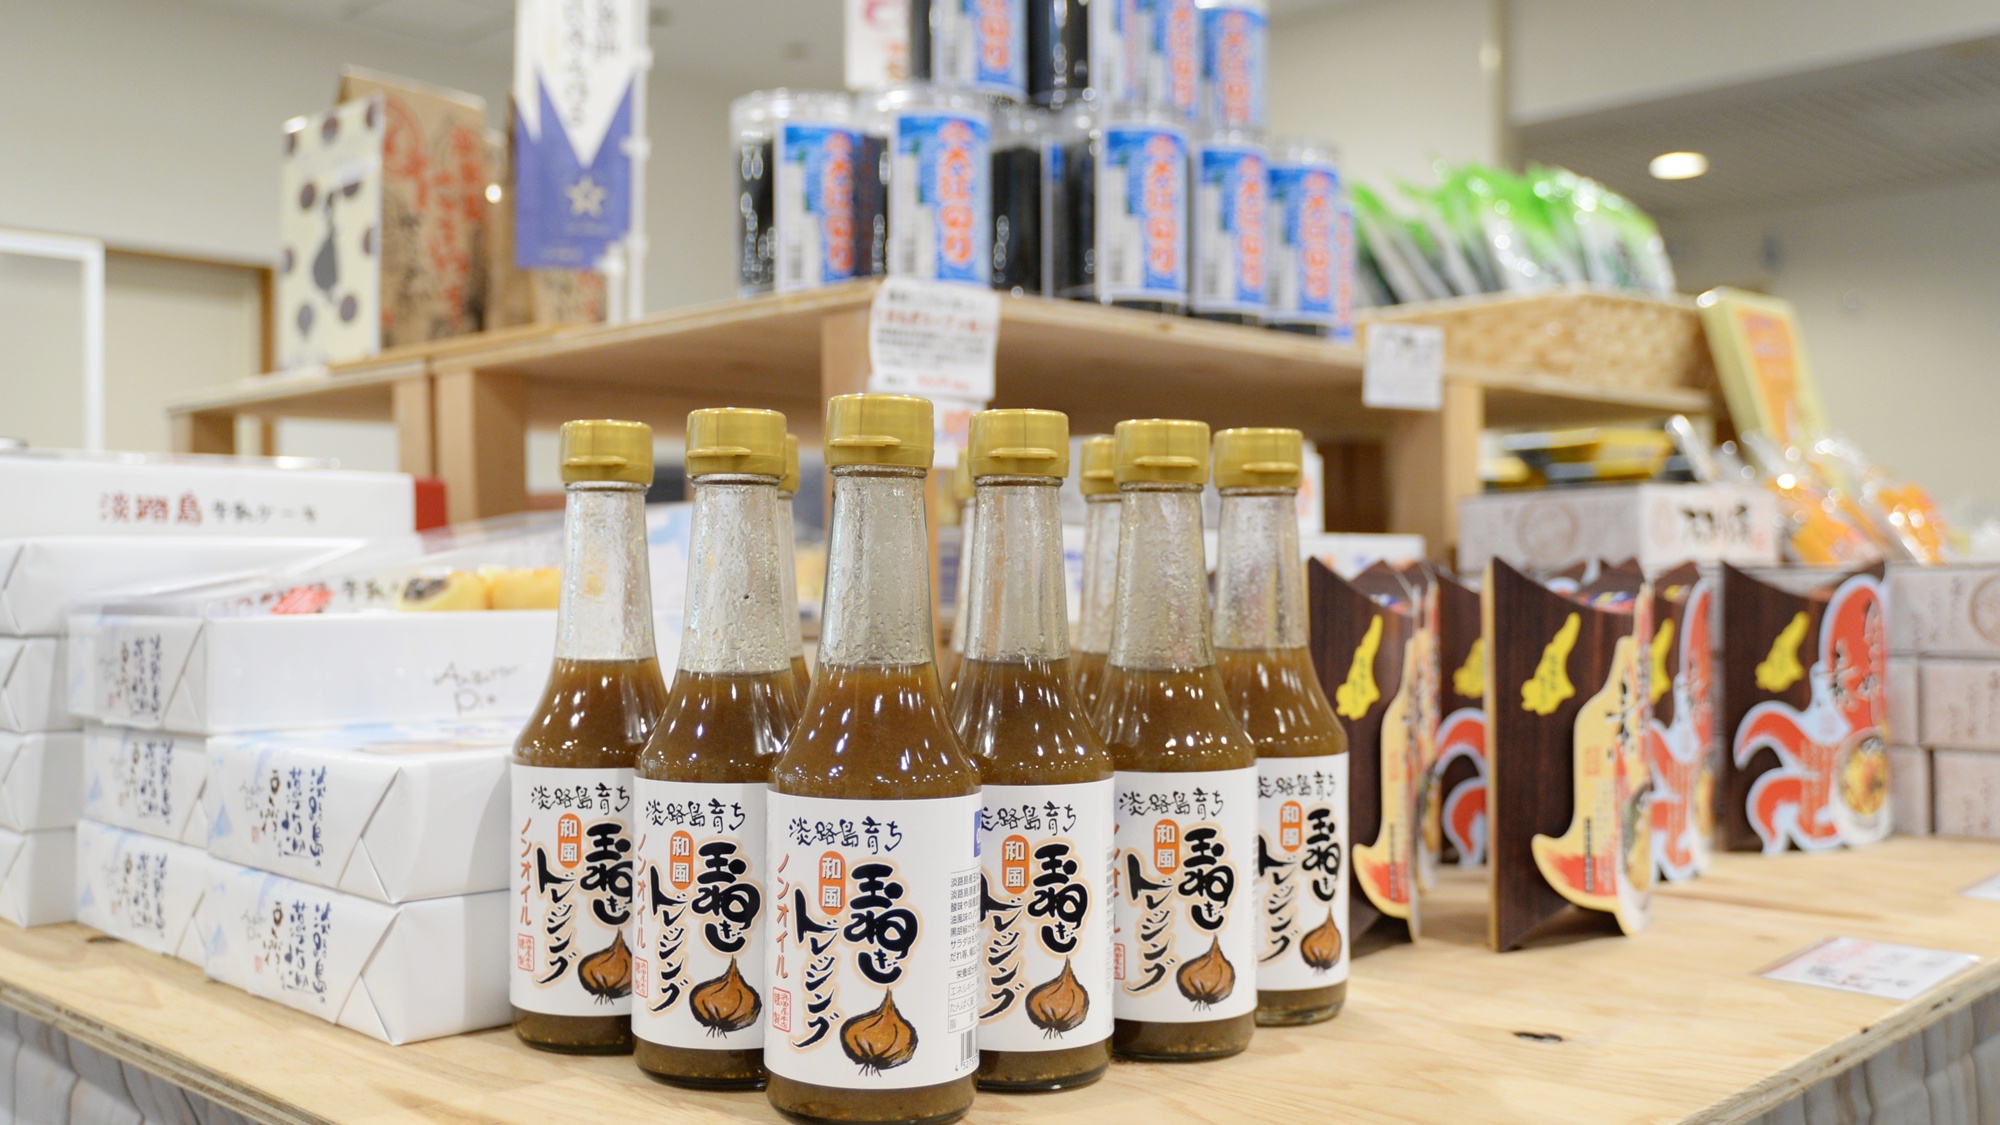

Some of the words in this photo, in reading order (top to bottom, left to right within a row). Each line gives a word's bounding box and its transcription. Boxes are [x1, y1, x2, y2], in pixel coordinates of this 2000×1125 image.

[531, 782, 631, 815] 淡路島育ち
[560, 818, 578, 862] 和風
[645, 798, 746, 833] 淡路島育ち
[789, 815, 902, 855] 淡路島育ち
[1118, 787, 1224, 820] 淡路島育ち
[1156, 824, 1176, 868] 和風
[520, 817, 532, 926] ノンオイル
[579, 823, 633, 925] 玉ねぎ
[636, 833, 647, 949] ノンオイル
[672, 836, 691, 883] 和風
[691, 842, 761, 953] 玉ねぎ
[821, 856, 843, 908] 和風
[1005, 840, 1025, 887] 和風
[1027, 844, 1088, 953] 玉ねぎ
[1178, 827, 1234, 930] 玉ねぎ
[1258, 834, 1298, 962] ドレッシング
[1302, 808, 1341, 902] 玉ねぎ
[536, 847, 577, 984] ドレッシング
[649, 865, 689, 1012] ドレッシング
[775, 853, 789, 979] ノンオイル
[792, 888, 840, 1048] ドレッシング
[843, 863, 918, 984] 玉ねぎ
[980, 872, 1025, 1019] ドレッシング
[1127, 853, 1175, 992] ドレッシング
